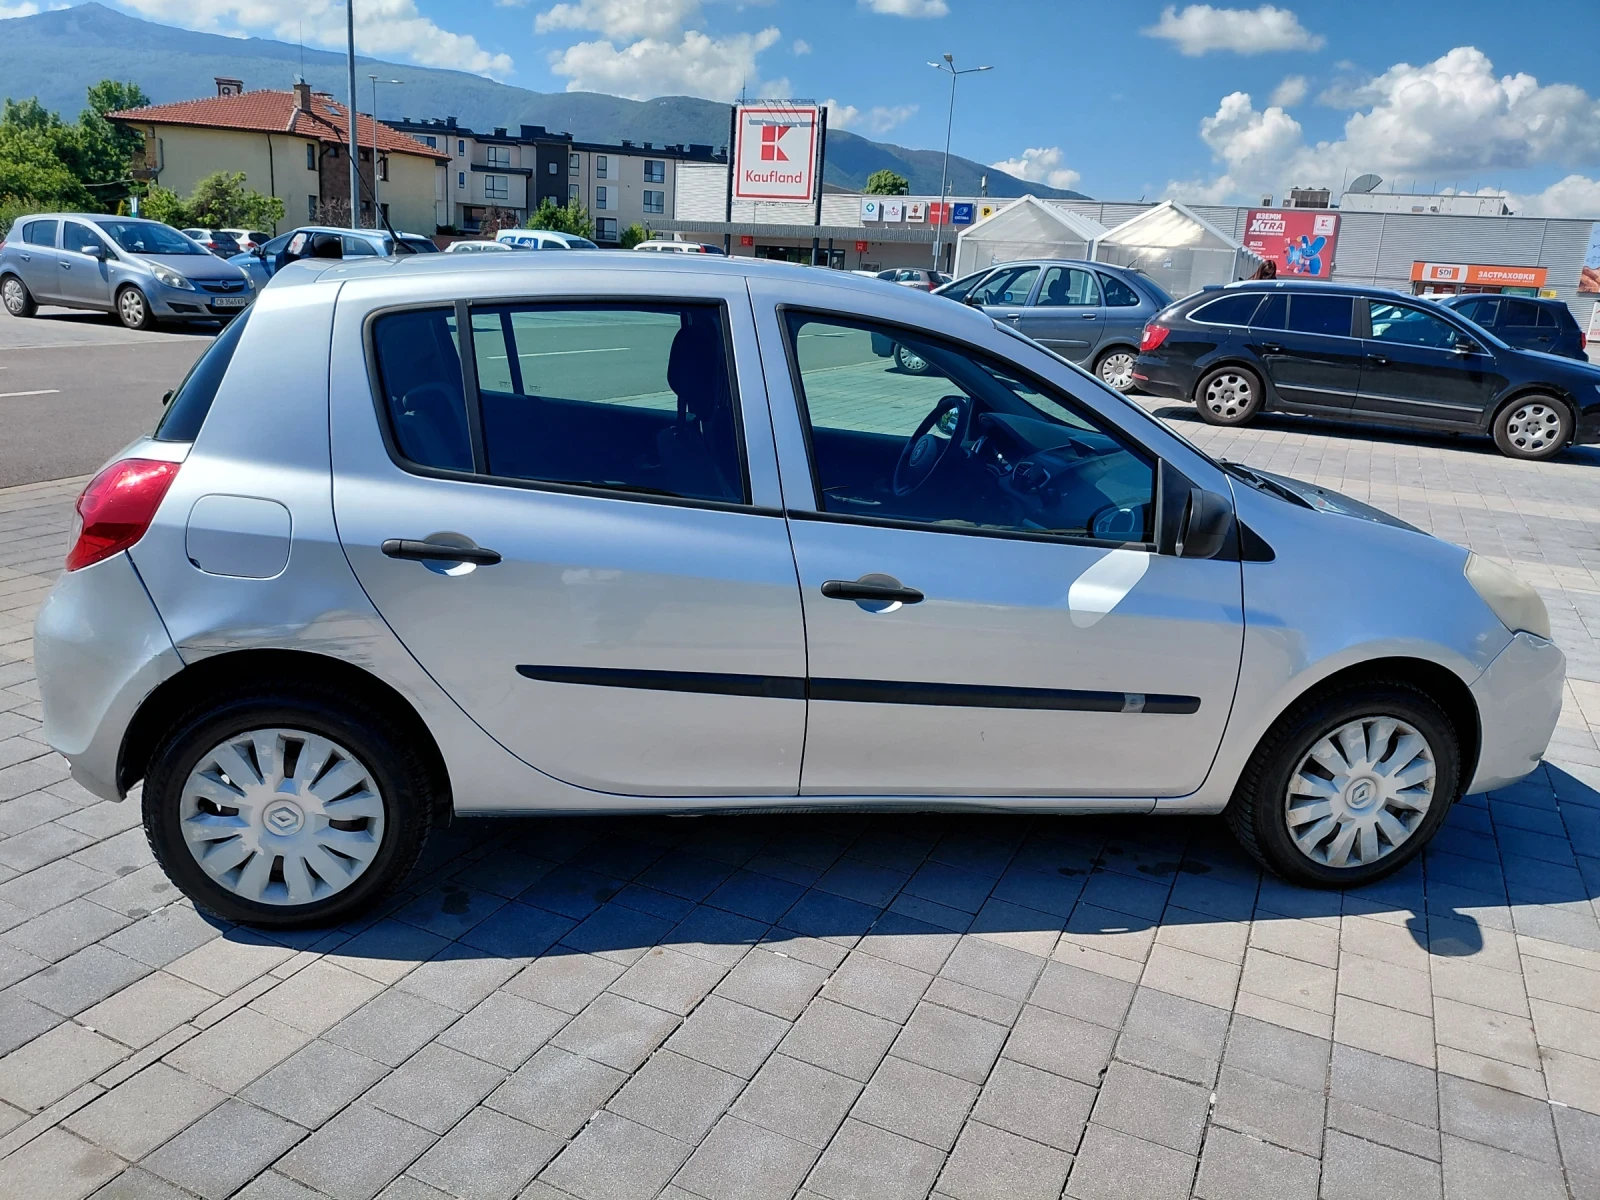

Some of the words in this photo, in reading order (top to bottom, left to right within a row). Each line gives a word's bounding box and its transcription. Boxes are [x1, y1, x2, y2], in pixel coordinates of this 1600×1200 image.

[745, 169, 802, 184] Kaufland
[1249, 219, 1286, 232] XTRA
[1438, 268, 1452, 276] SDI
[1478, 271, 1535, 280] ЗАСТРАХОВКИ
